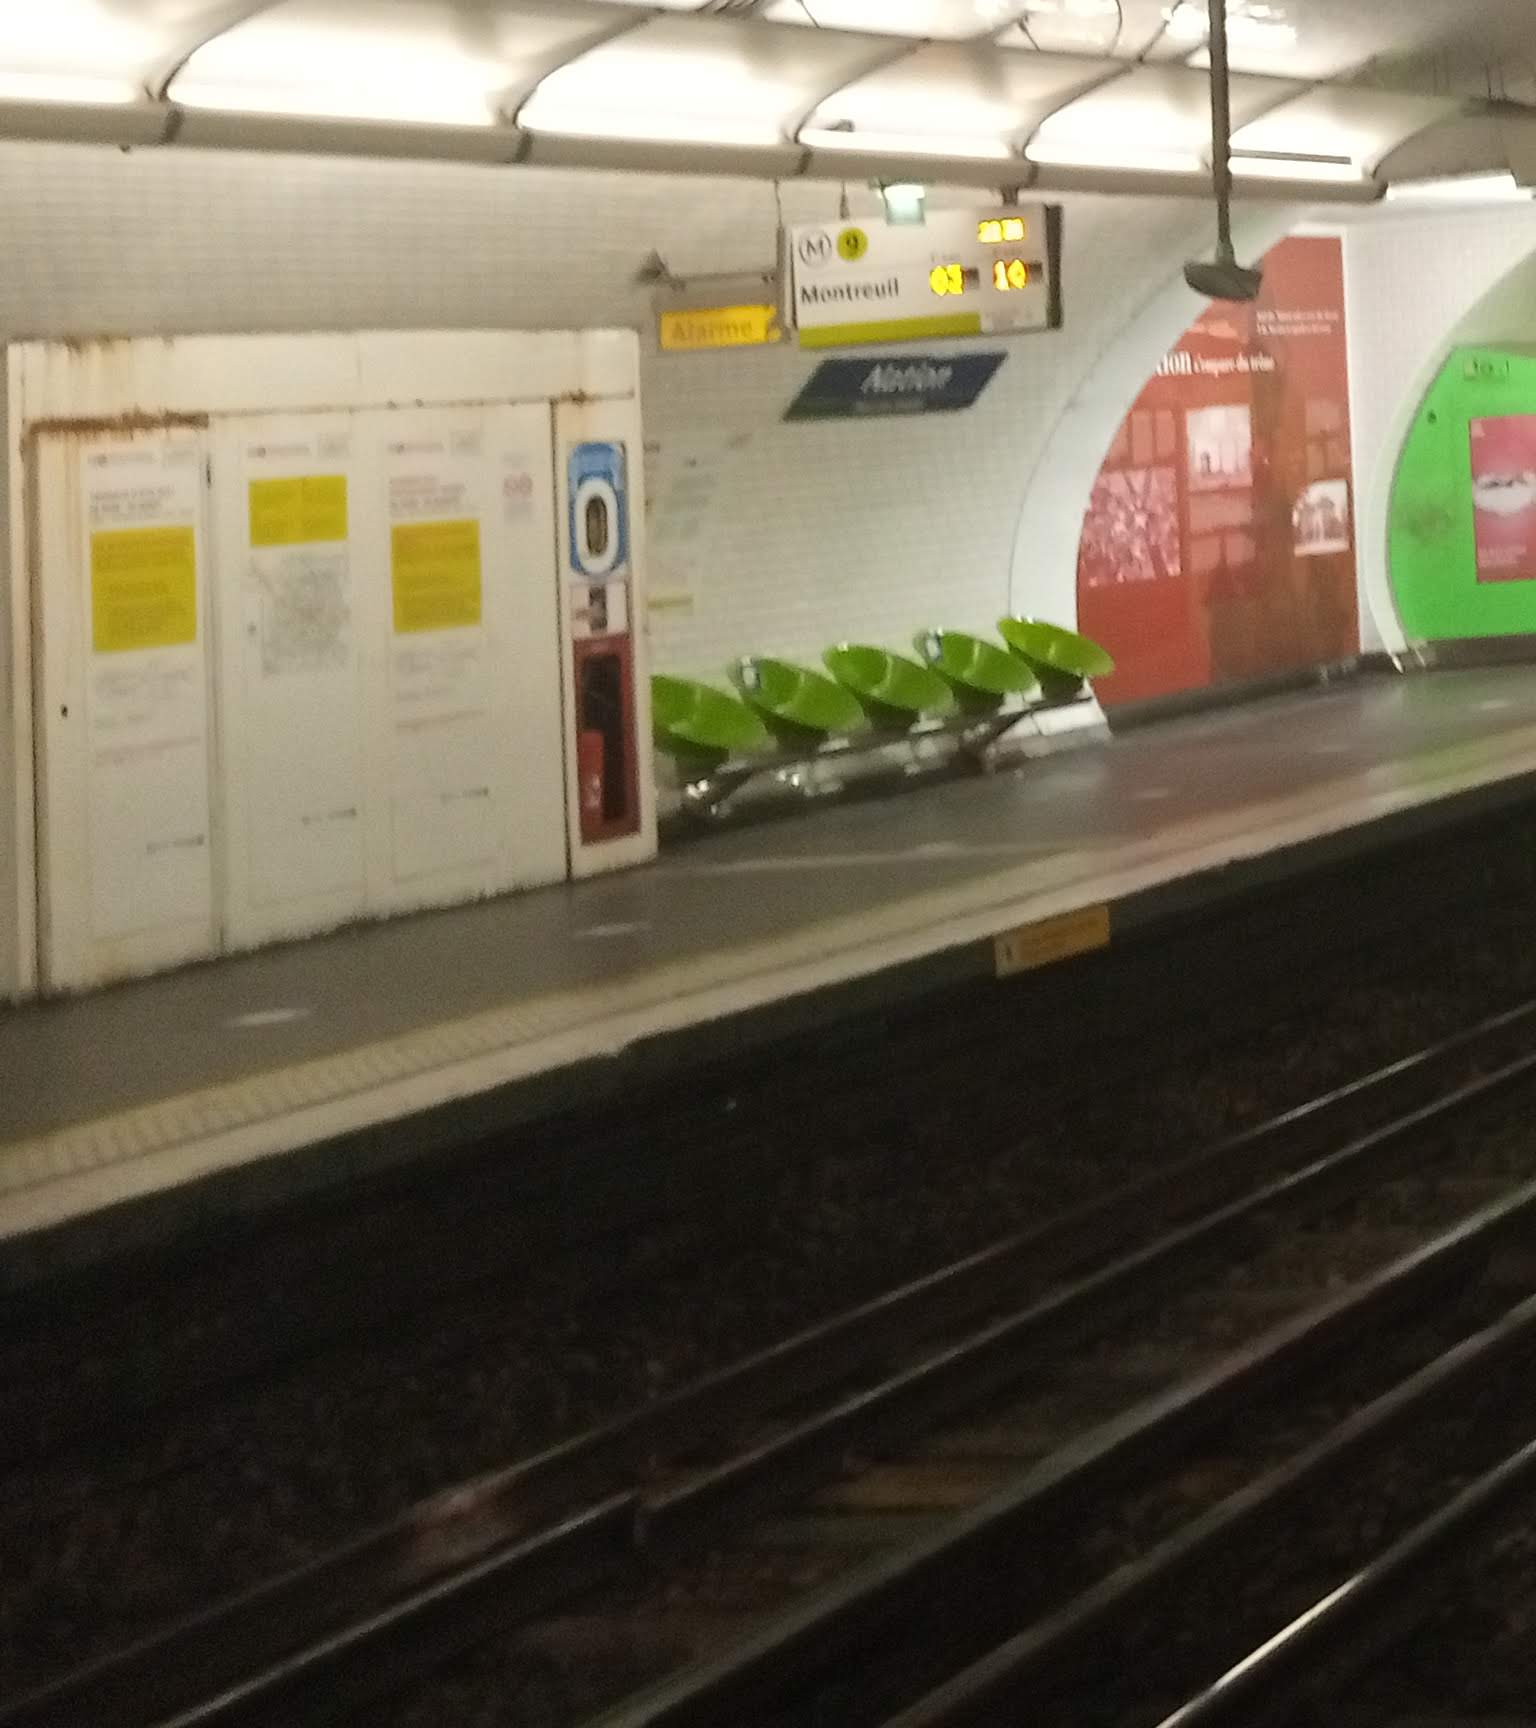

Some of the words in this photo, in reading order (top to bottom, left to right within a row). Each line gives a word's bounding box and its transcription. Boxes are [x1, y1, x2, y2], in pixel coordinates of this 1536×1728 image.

[845, 235, 859, 251] 9
[801, 277, 899, 304] Montreuil
[671, 317, 754, 341] Alarme
